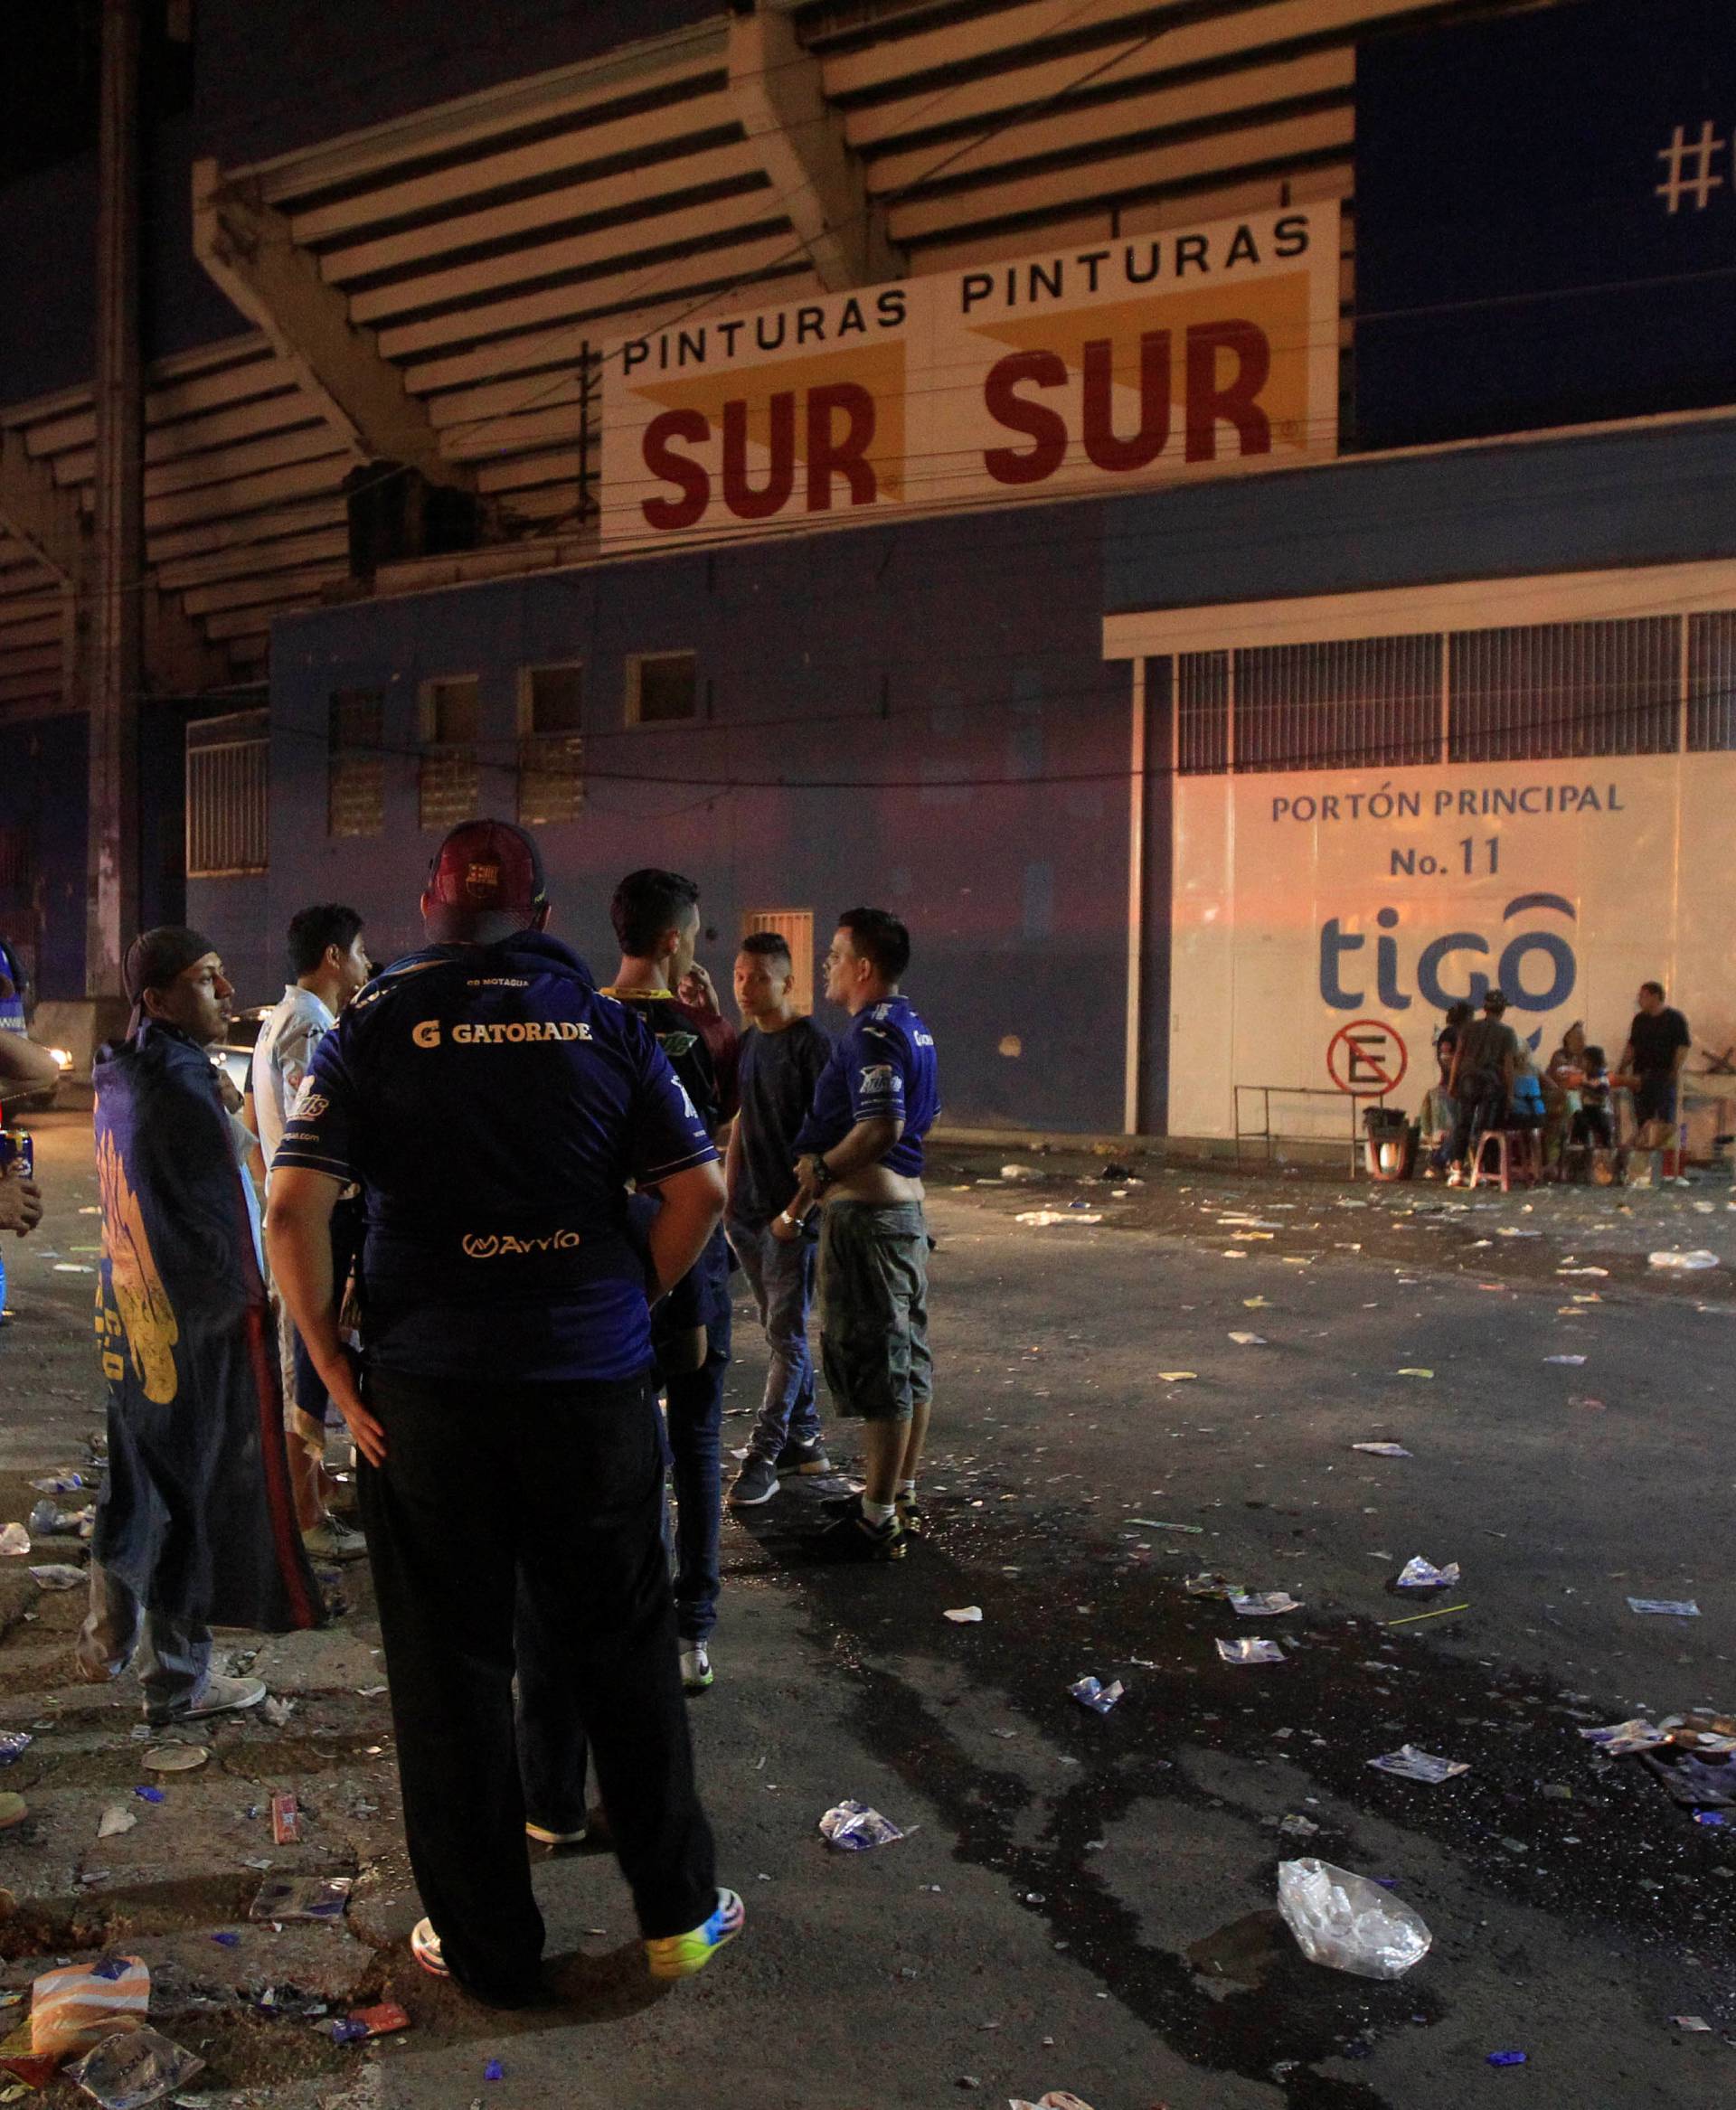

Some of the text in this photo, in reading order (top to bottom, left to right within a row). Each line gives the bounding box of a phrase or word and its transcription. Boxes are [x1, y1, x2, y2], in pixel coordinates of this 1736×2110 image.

[960, 215, 1310, 314] PINTURAS
[623, 290, 907, 376] PINTURAS
[984, 318, 1272, 485] SUR
[641, 381, 877, 531] SUR
[1272, 783, 1626, 822] PORTÓN PRINCIPAL
[1390, 836, 1501, 876] No. 11
[482, 978, 530, 987] MOTAGUA
[452, 1022, 592, 1043] GATORADE
[1348, 1034, 1387, 1083] E
